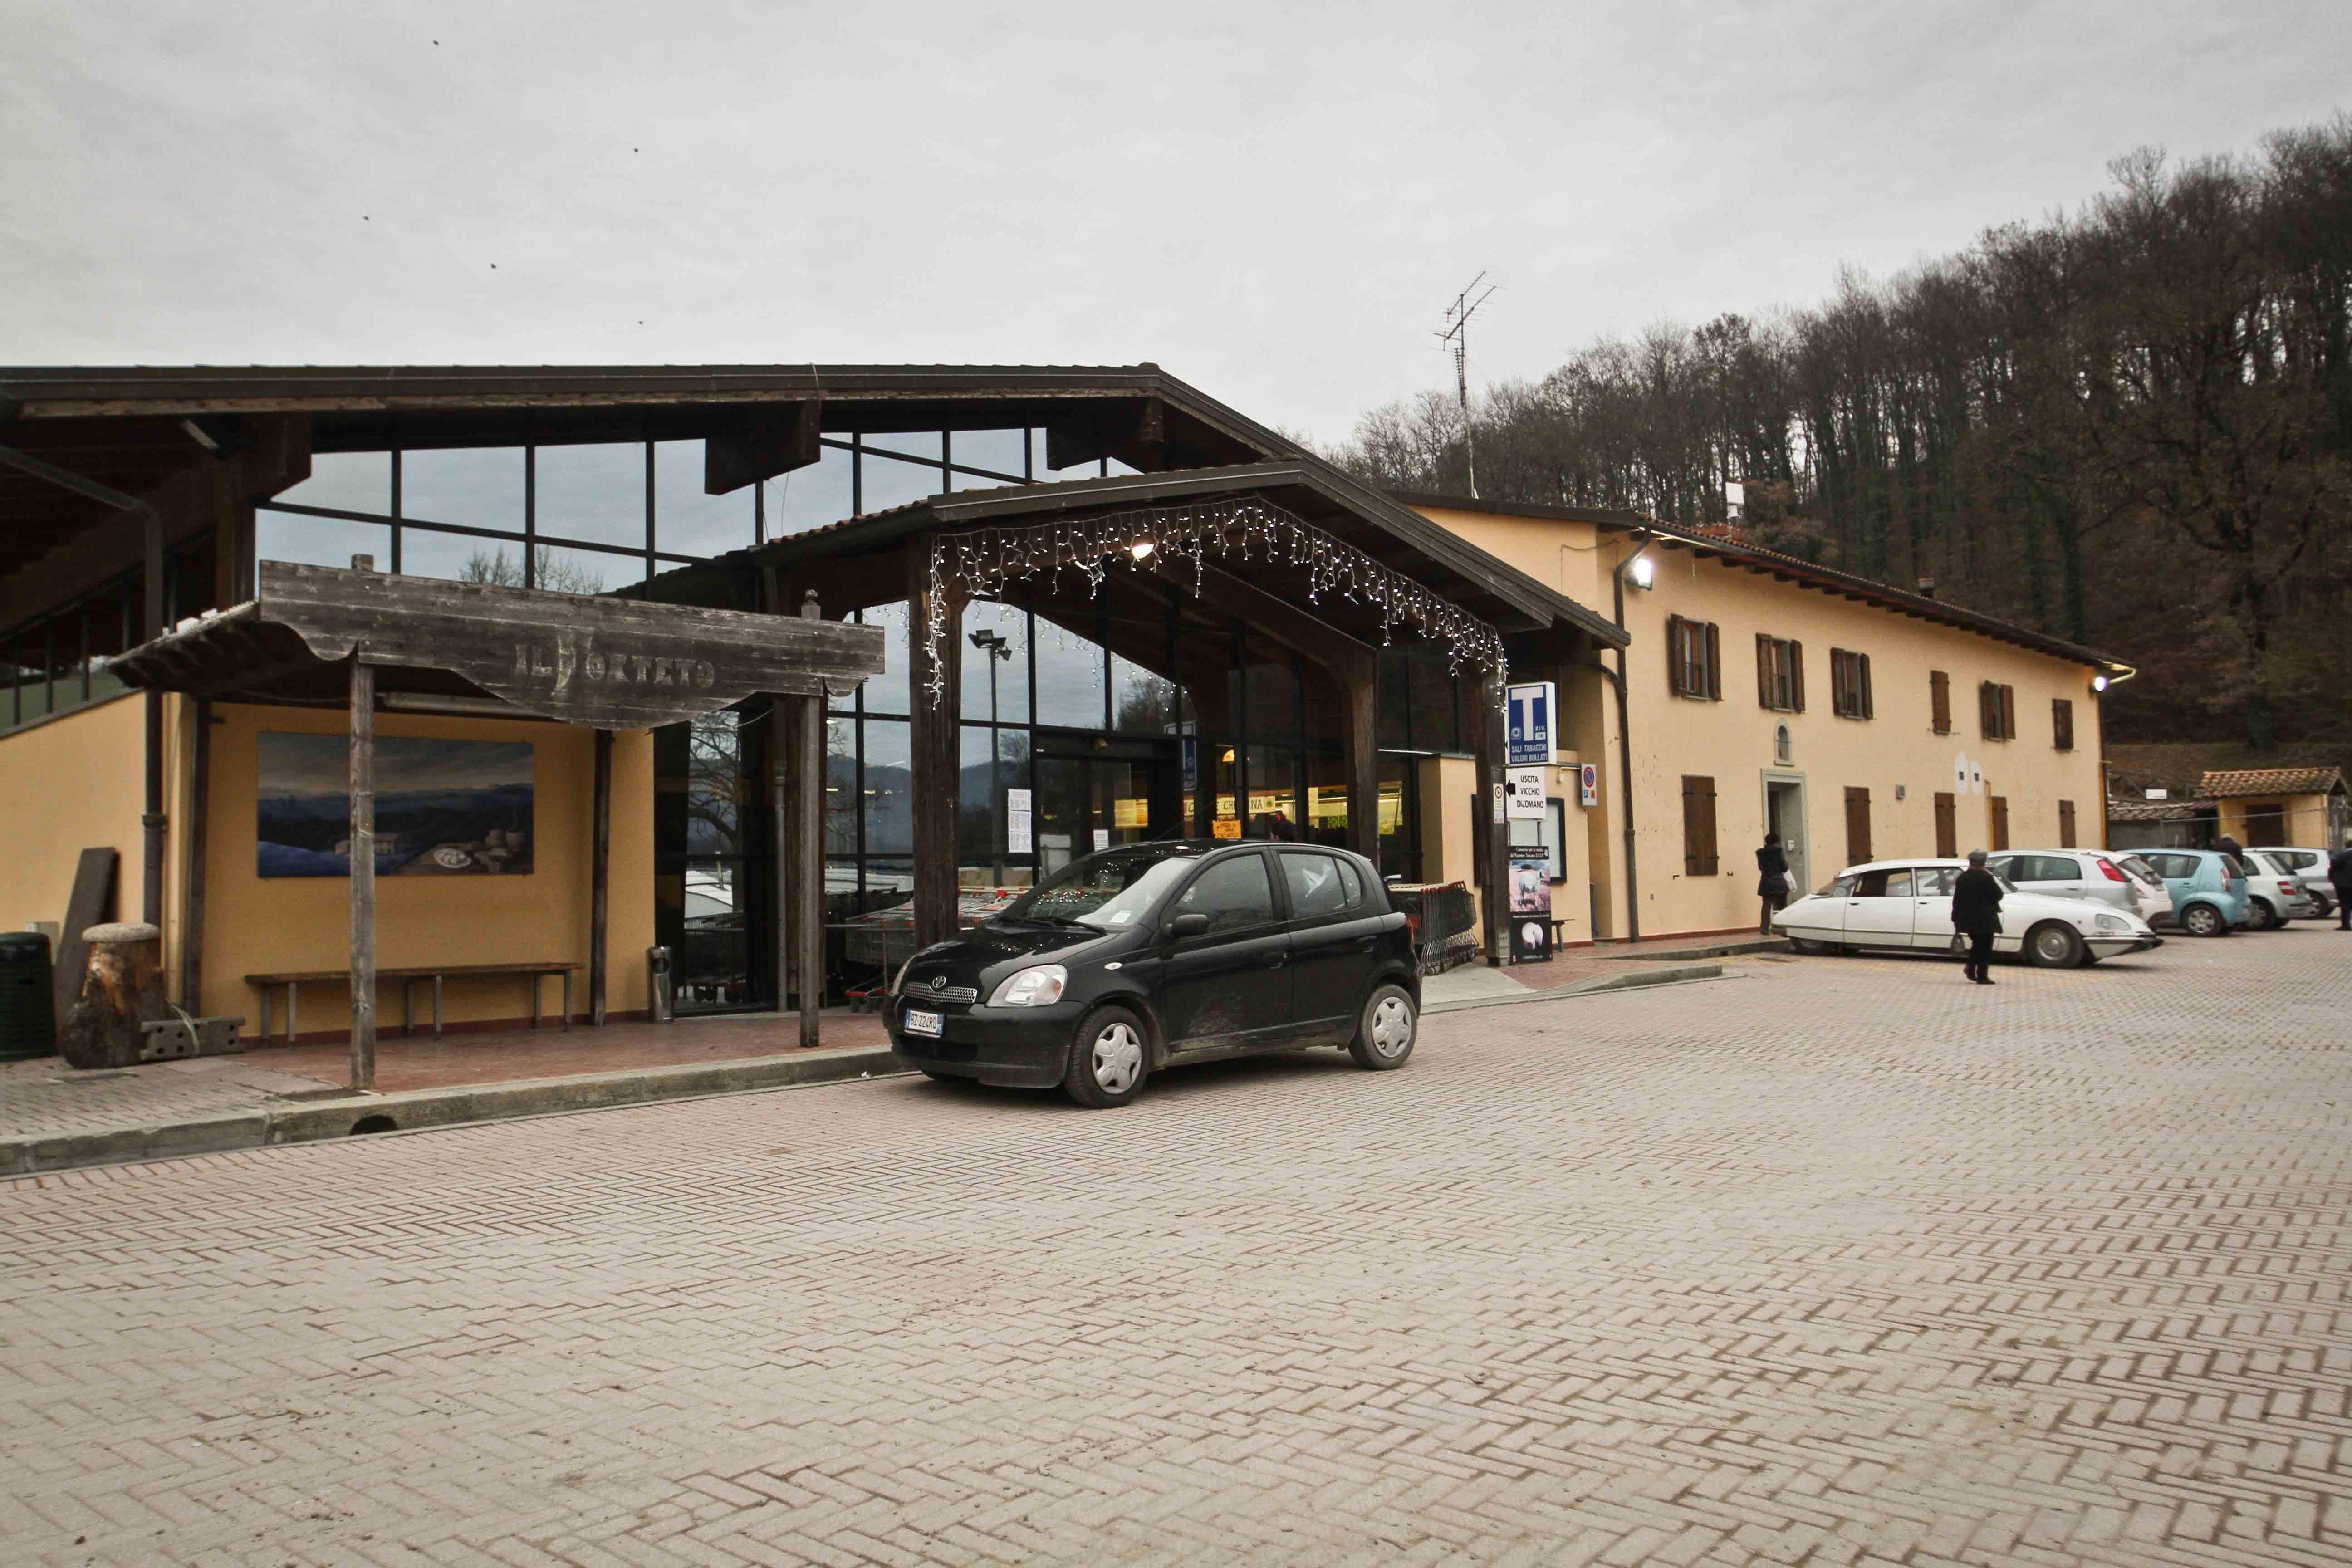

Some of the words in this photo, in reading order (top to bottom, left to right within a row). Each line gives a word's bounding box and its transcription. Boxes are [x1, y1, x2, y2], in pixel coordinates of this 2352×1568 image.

[1511, 686, 1544, 741] T
[1511, 745, 1522, 753] SALI
[1524, 744, 1547, 752] TABACCHI
[1511, 755, 1528, 763] VALORI
[1529, 753, 1547, 762] BOLLATI
